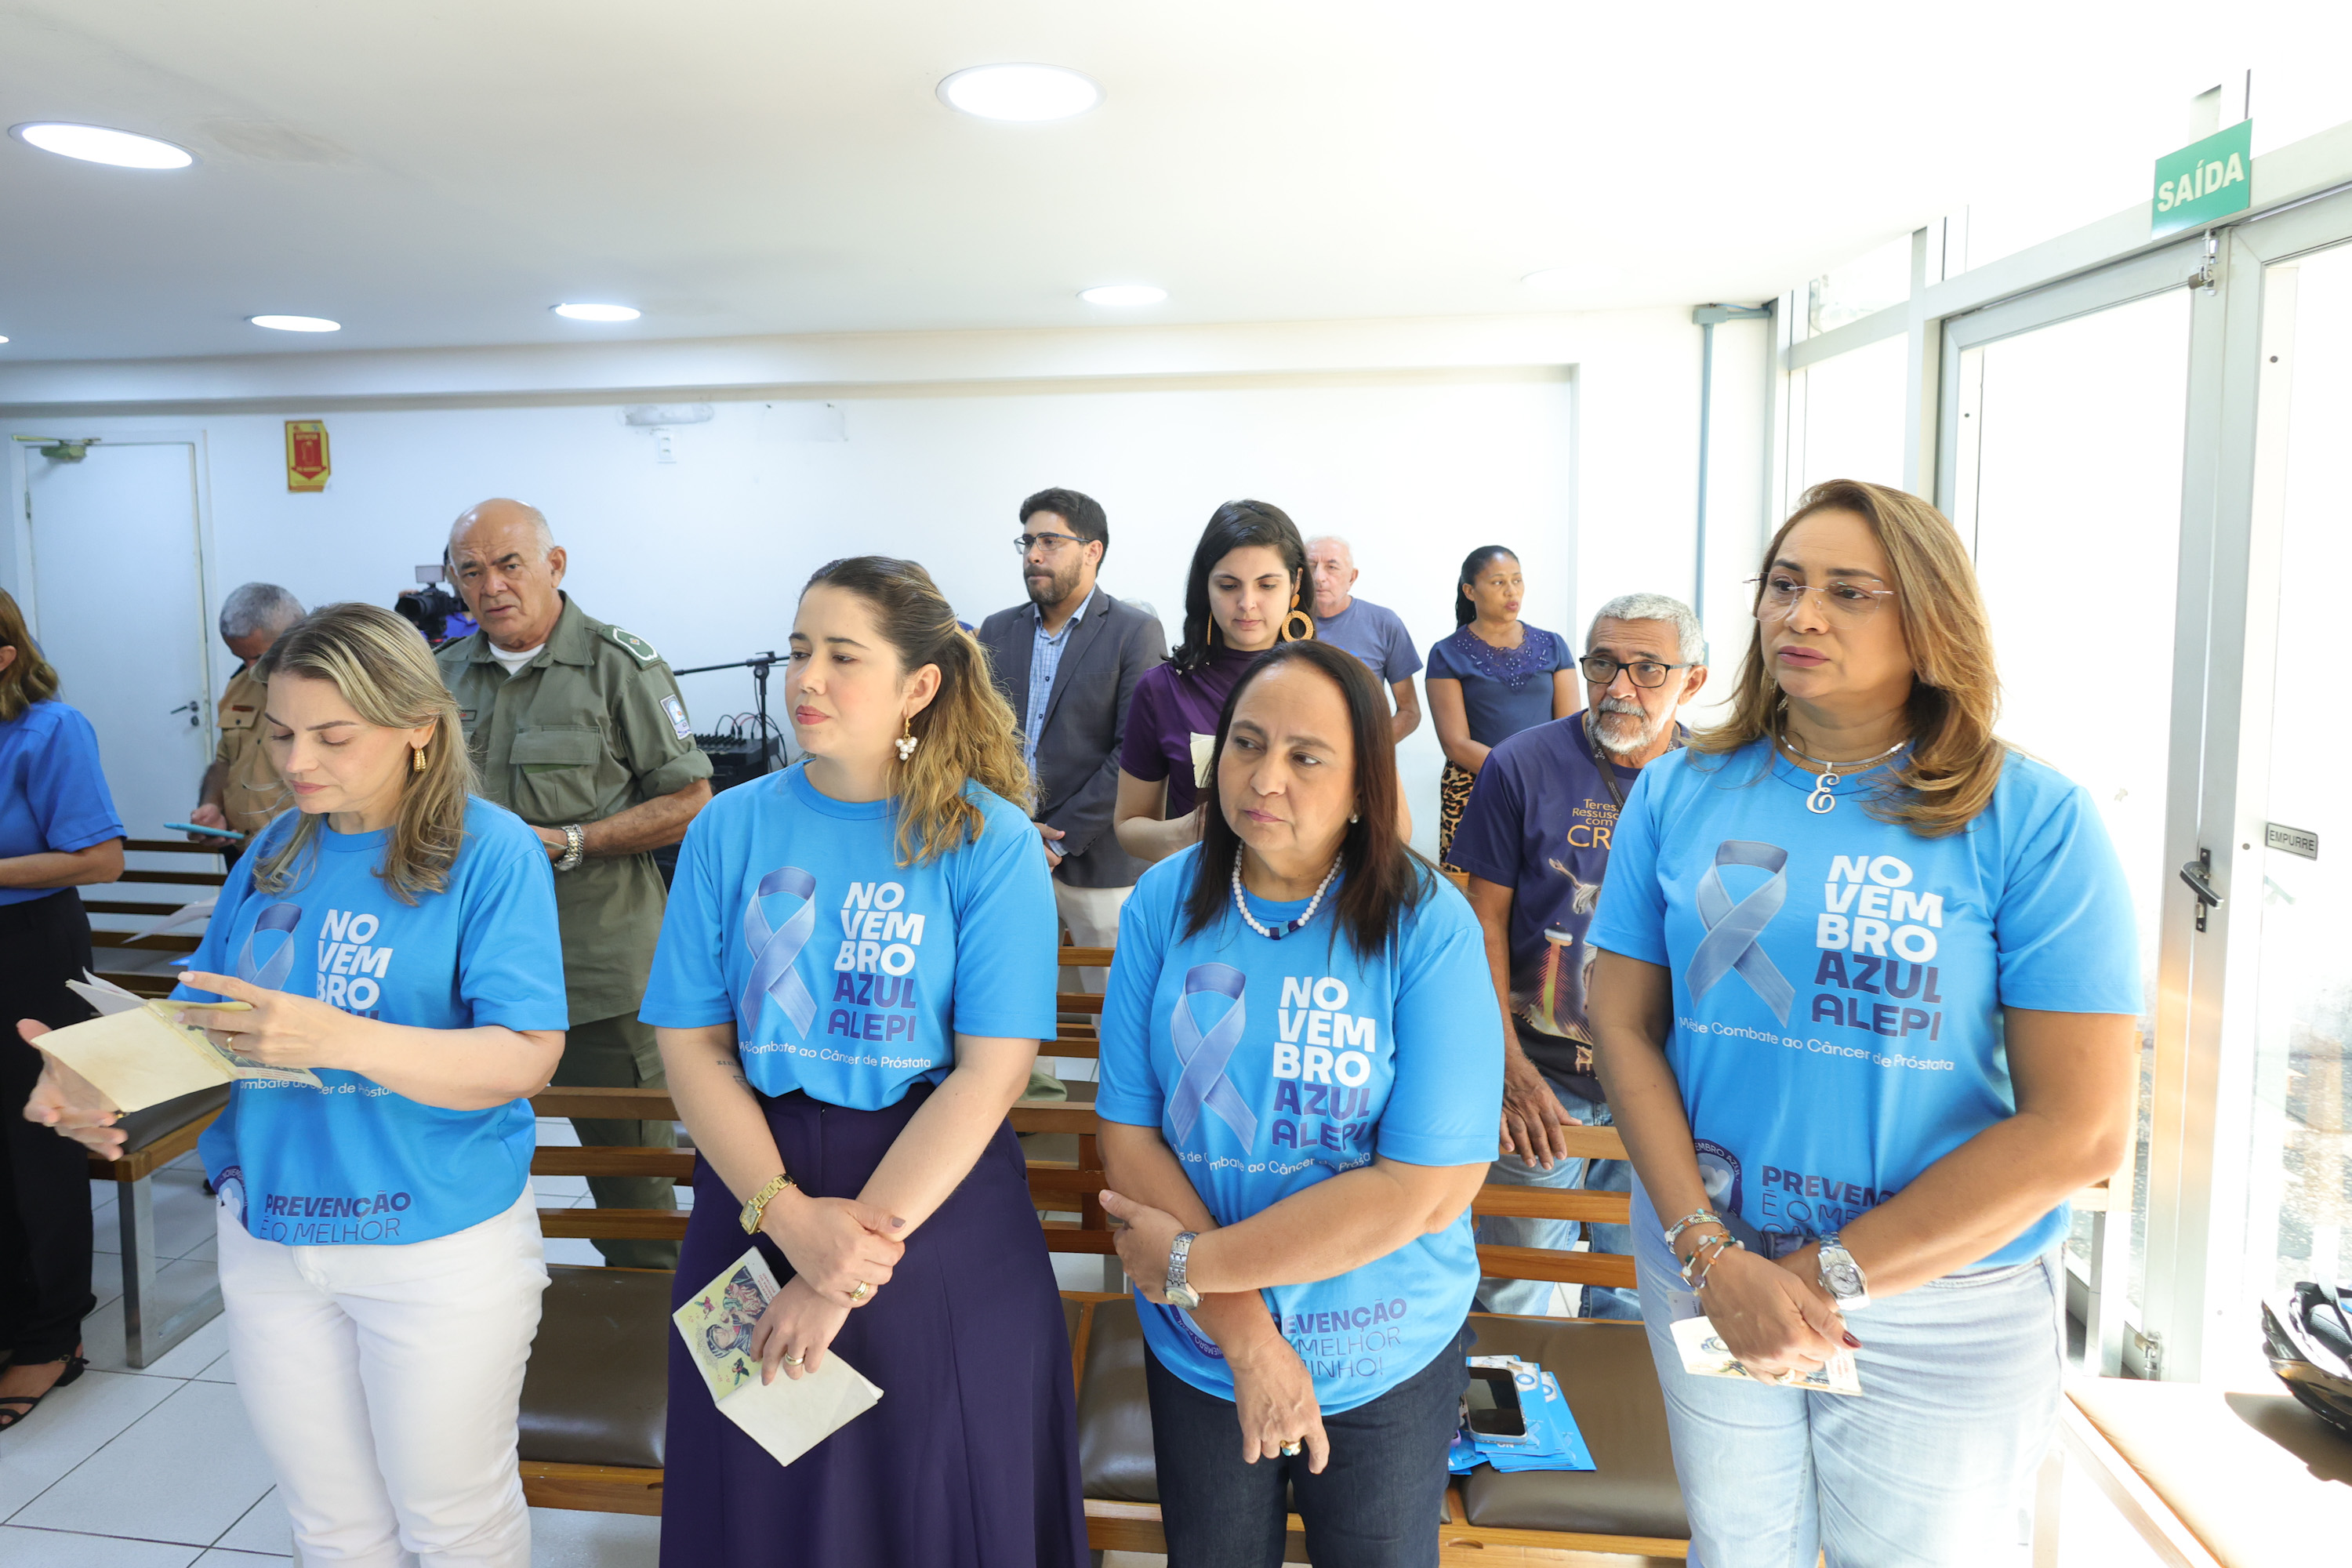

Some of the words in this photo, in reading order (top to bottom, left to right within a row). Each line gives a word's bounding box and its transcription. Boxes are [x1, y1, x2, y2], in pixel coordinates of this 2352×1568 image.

[2157, 152, 2245, 212] SAÍDA
[1572, 808, 1619, 821] Ressusc
[1583, 798, 1618, 812] Teres
[1585, 818, 1613, 827] com
[1567, 824, 1612, 850] CR
[2269, 829, 2314, 851] EMPURRE
[1827, 855, 1914, 888] NO
[842, 881, 906, 911] NO
[1824, 883, 1944, 928] VEM
[319, 909, 380, 945] NO
[840, 909, 926, 946] VEM
[1816, 913, 1938, 964] BRO
[318, 939, 394, 979] VEM
[833, 940, 916, 977] BRO
[316, 971, 381, 1011] BRO
[833, 971, 916, 1009] AZUL
[1279, 975, 1349, 1011] NO
[1813, 949, 1942, 1004] AZUL
[827, 1008, 916, 1043] ALEPI
[1277, 1007, 1376, 1054] VEM
[1811, 993, 1942, 1042] ALEPI
[799, 1047, 817, 1058] ao
[820, 1048, 861, 1065] Câncer
[863, 1054, 878, 1066] de
[880, 1056, 932, 1069] Próstata
[1272, 1041, 1371, 1087] BRO
[1711, 1022, 1779, 1045] Combate
[1782, 1036, 1803, 1050] ao
[1807, 1038, 1871, 1061] Câncer
[1873, 1051, 1892, 1069] de
[1893, 1054, 1955, 1071] Próstata
[338, 1083, 356, 1094] de
[1273, 1079, 1371, 1121] AZUL
[1272, 1118, 1368, 1152] ALEPI
[1187, 1151, 1203, 1163] de
[1247, 1163, 1265, 1173] ao
[1269, 1157, 1316, 1175] Câncer
[1726, 1155, 1740, 1178] AZUL
[1762, 1164, 1897, 1209] PREVEN
[265, 1189, 412, 1222] PREVENÇÃO
[1762, 1189, 1778, 1218] É
[1787, 1200, 1813, 1223] O
[271, 1222, 288, 1243] O
[292, 1218, 401, 1244] MELHOR
[1298, 1327, 1401, 1357] MELHOR
[1302, 1356, 1384, 1378] INHO!
